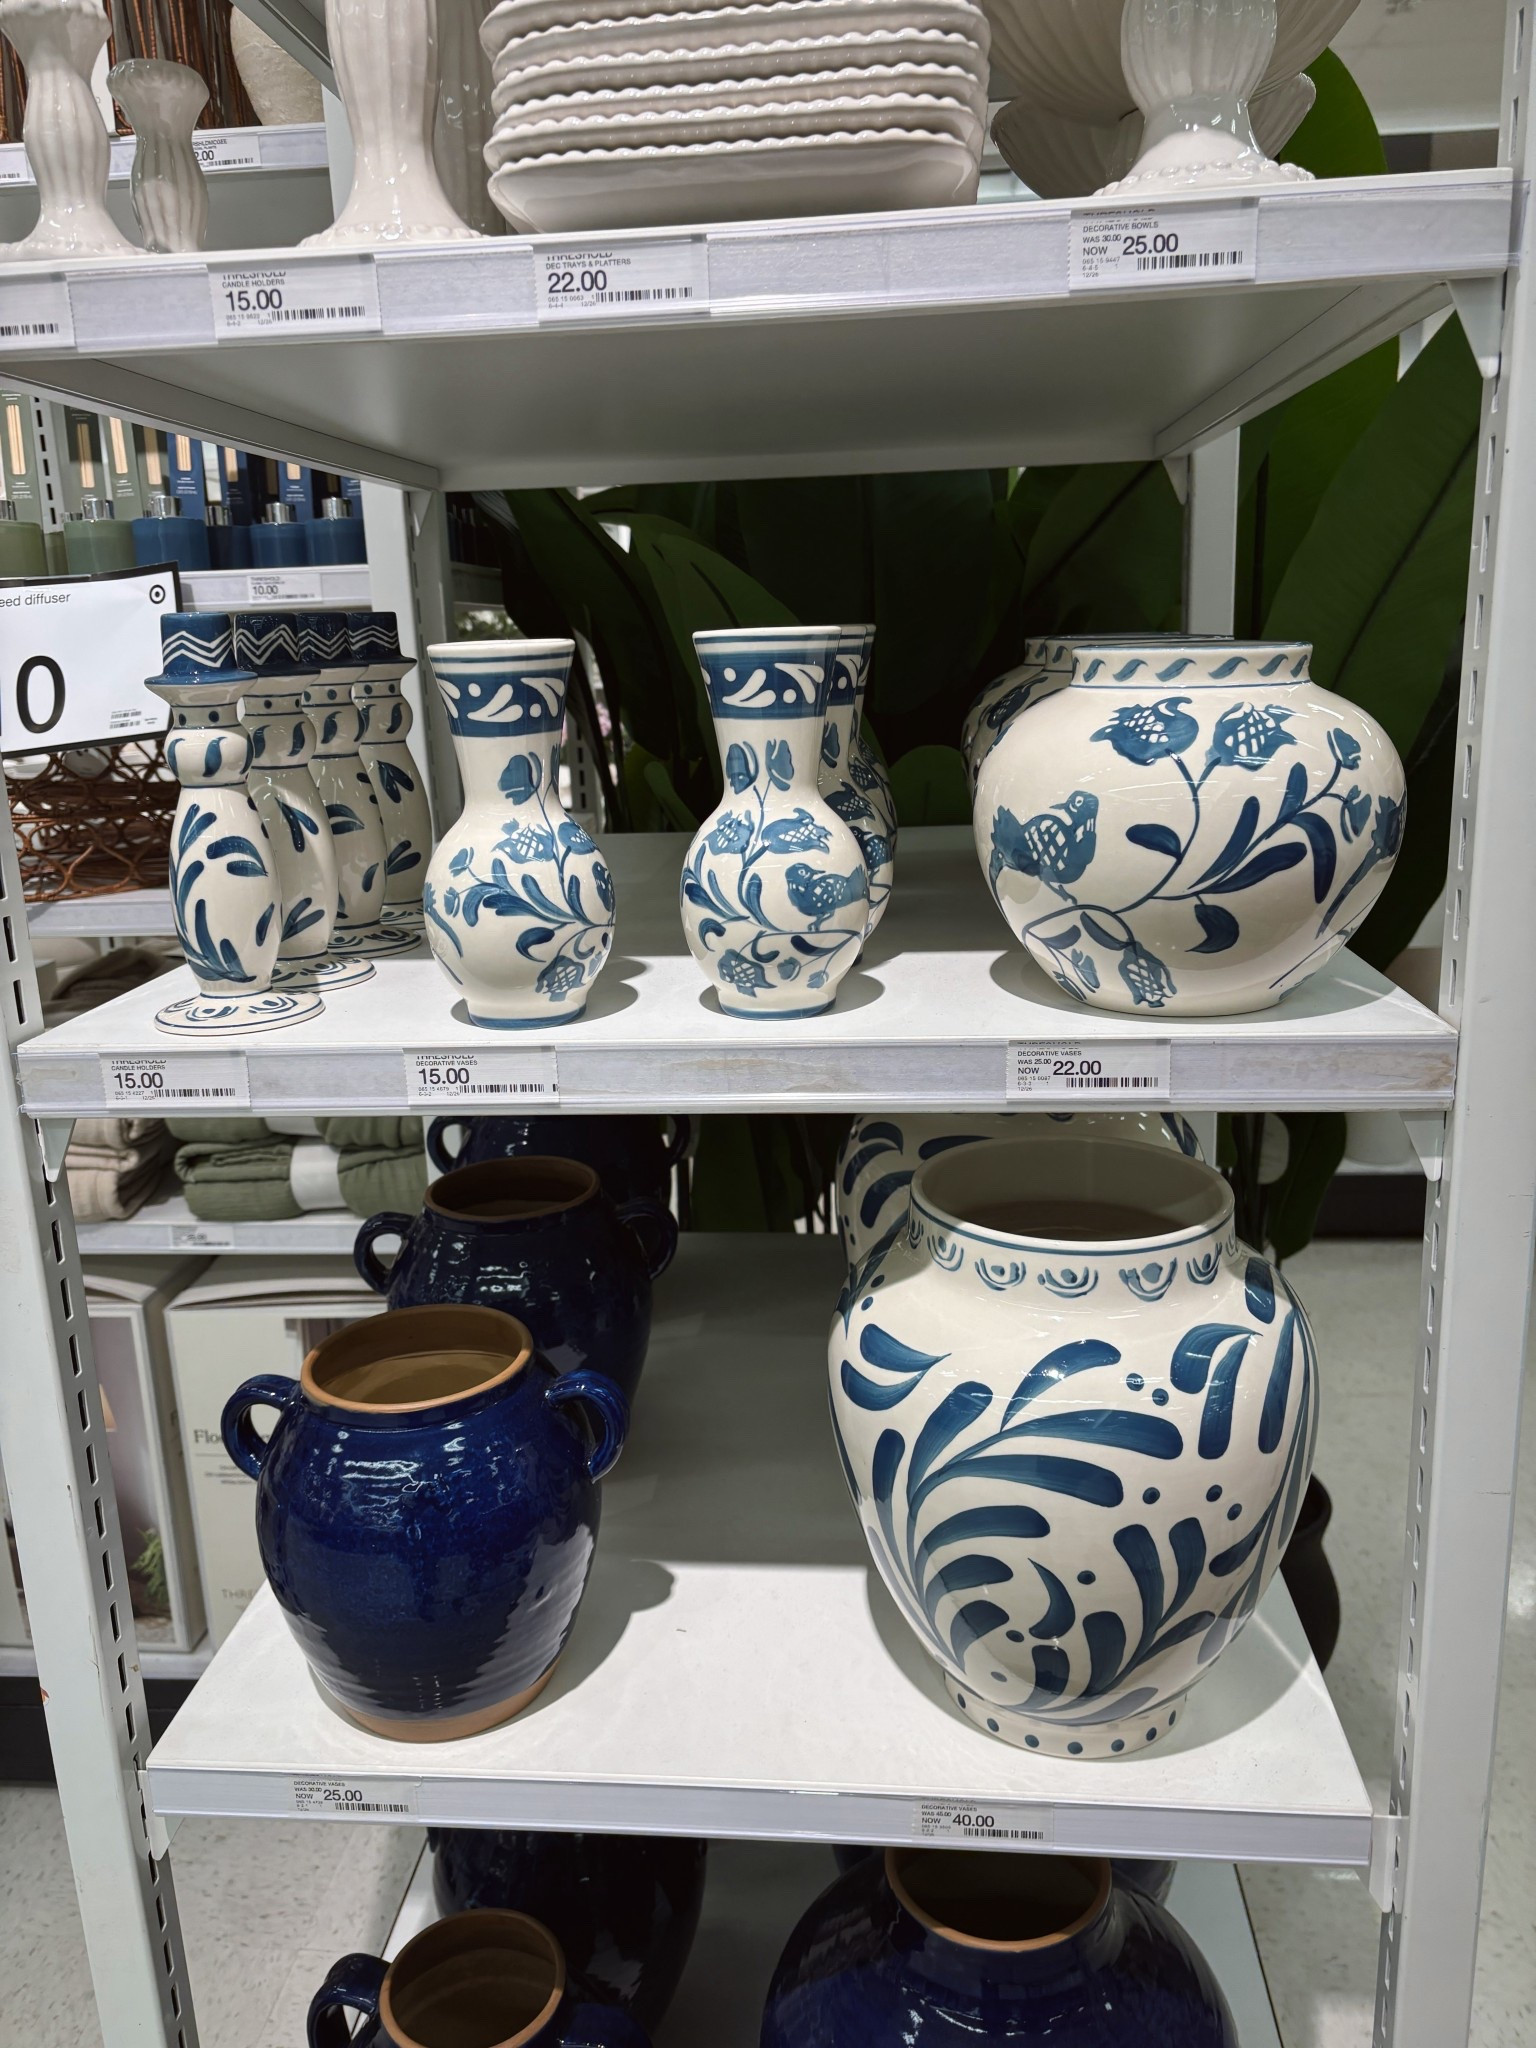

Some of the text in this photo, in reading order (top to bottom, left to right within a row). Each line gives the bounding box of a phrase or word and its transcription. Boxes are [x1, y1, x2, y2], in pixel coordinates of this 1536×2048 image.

[194, 150, 214, 162] 2.00
[1083, 221, 1159, 233] DECORATIVE BOWLS
[1082, 234, 1122, 244] WAS 30.00
[1082, 233, 1179, 256] NOW 25.00
[546, 258, 632, 270] DEC TRAYS & PLATTERS
[222, 278, 285, 288] CANDLE HOLDERS
[548, 270, 608, 294] 22.00
[225, 288, 282, 312] 15.00
[252, 585, 278, 595] 10.00
[0, 592, 72, 608] eed diffuser
[16, 655, 66, 734] 0
[1053, 1060, 1102, 1076] 22.00
[114, 1072, 164, 1088] 15.00
[418, 1068, 470, 1084] 15.00
[324, 1789, 362, 1802] 25.00
[952, 1814, 994, 1828] 40.00
